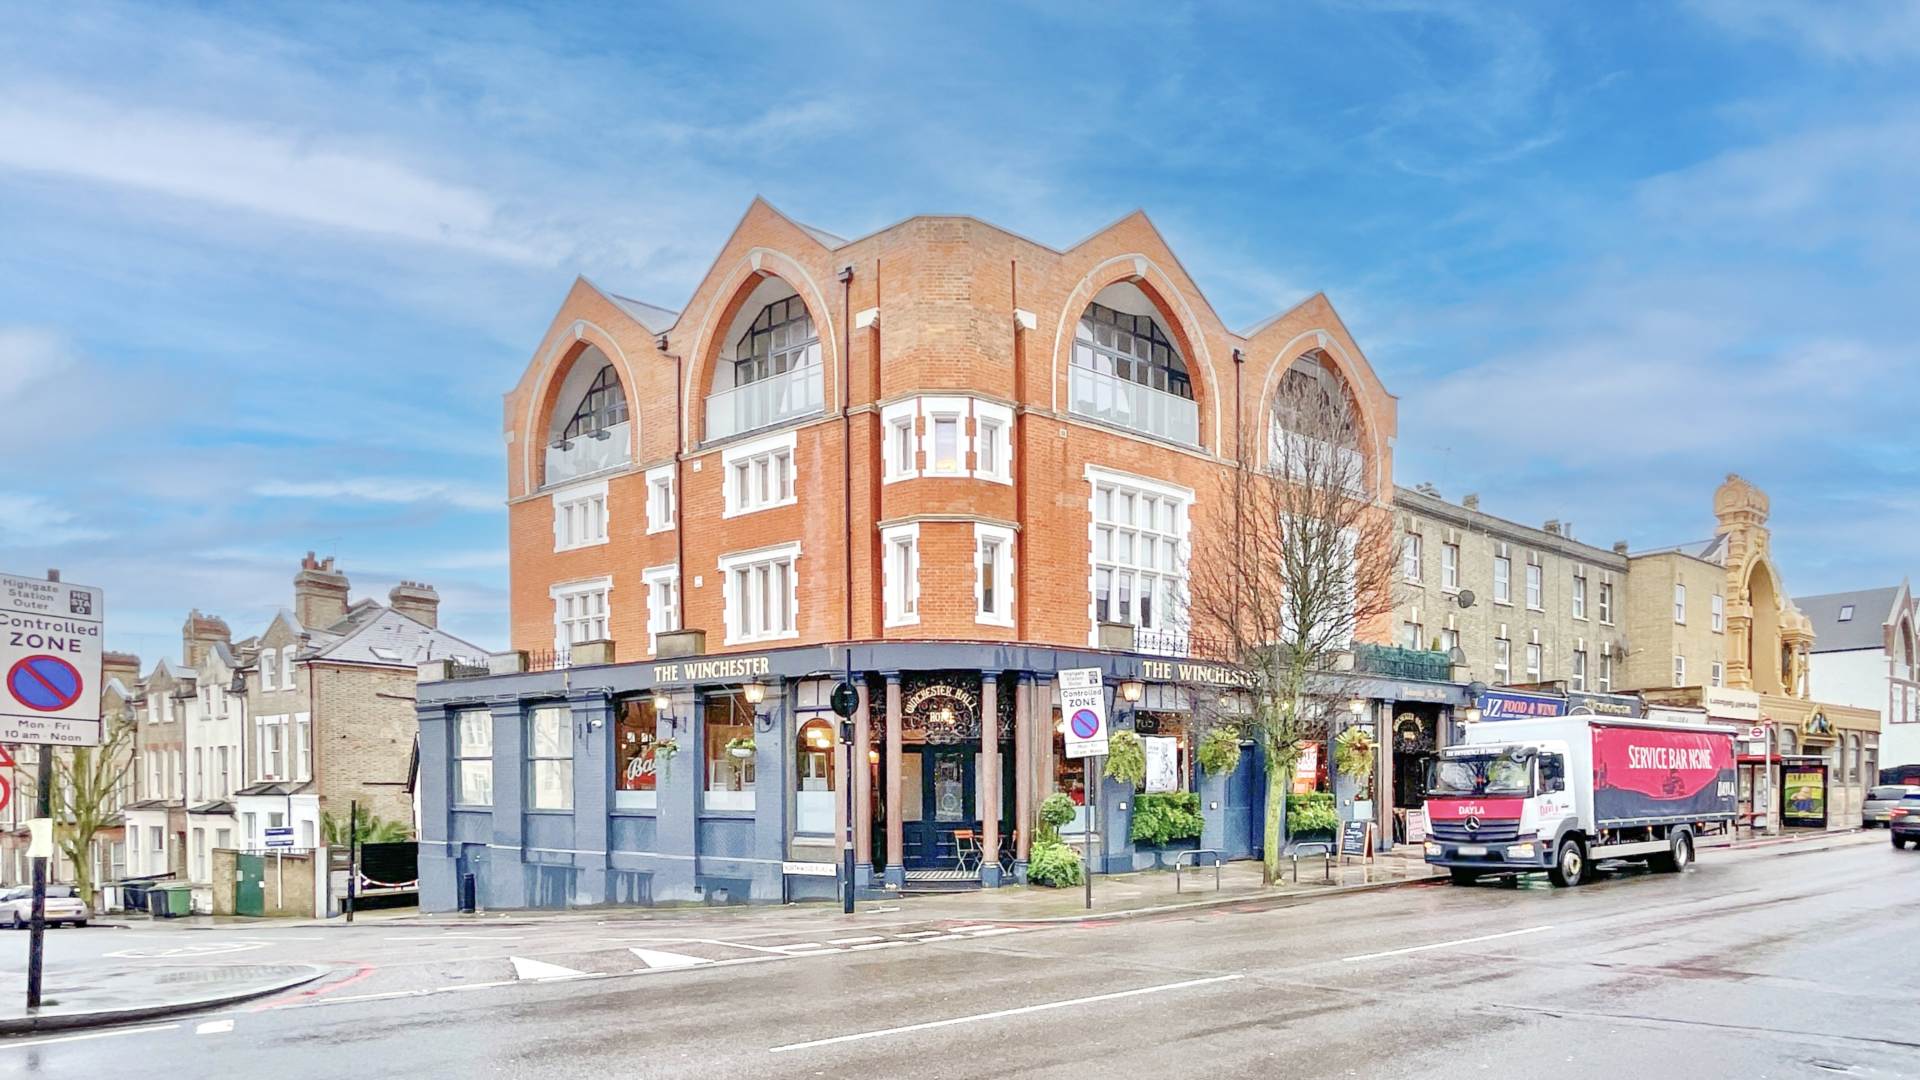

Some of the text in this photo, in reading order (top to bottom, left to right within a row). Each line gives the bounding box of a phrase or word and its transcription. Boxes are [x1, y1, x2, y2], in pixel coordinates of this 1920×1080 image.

[3, 579, 58, 593] Highgate
[8, 588, 54, 601] Station
[14, 599, 48, 610] Outer
[0, 613, 98, 637] Controlled
[10, 632, 81, 653] ZONE
[654, 657, 769, 682] THE WINCHESTER
[1143, 661, 1172, 679] THE
[905, 685, 977, 714] WINCHESTER HALL
[1063, 689, 1102, 698] Controlled
[1069, 698, 1096, 708] ZONE
[1483, 698, 1502, 717] JZ
[1503, 700, 1527, 714] FOOD
[1537, 704, 1558, 716] WINE
[18, 720, 71, 731] Mon Fri
[5, 730, 82, 742] 10 am Noon
[1628, 745, 1713, 770] SERVICE BAR NONE
[1458, 806, 1486, 815] DAYLA
